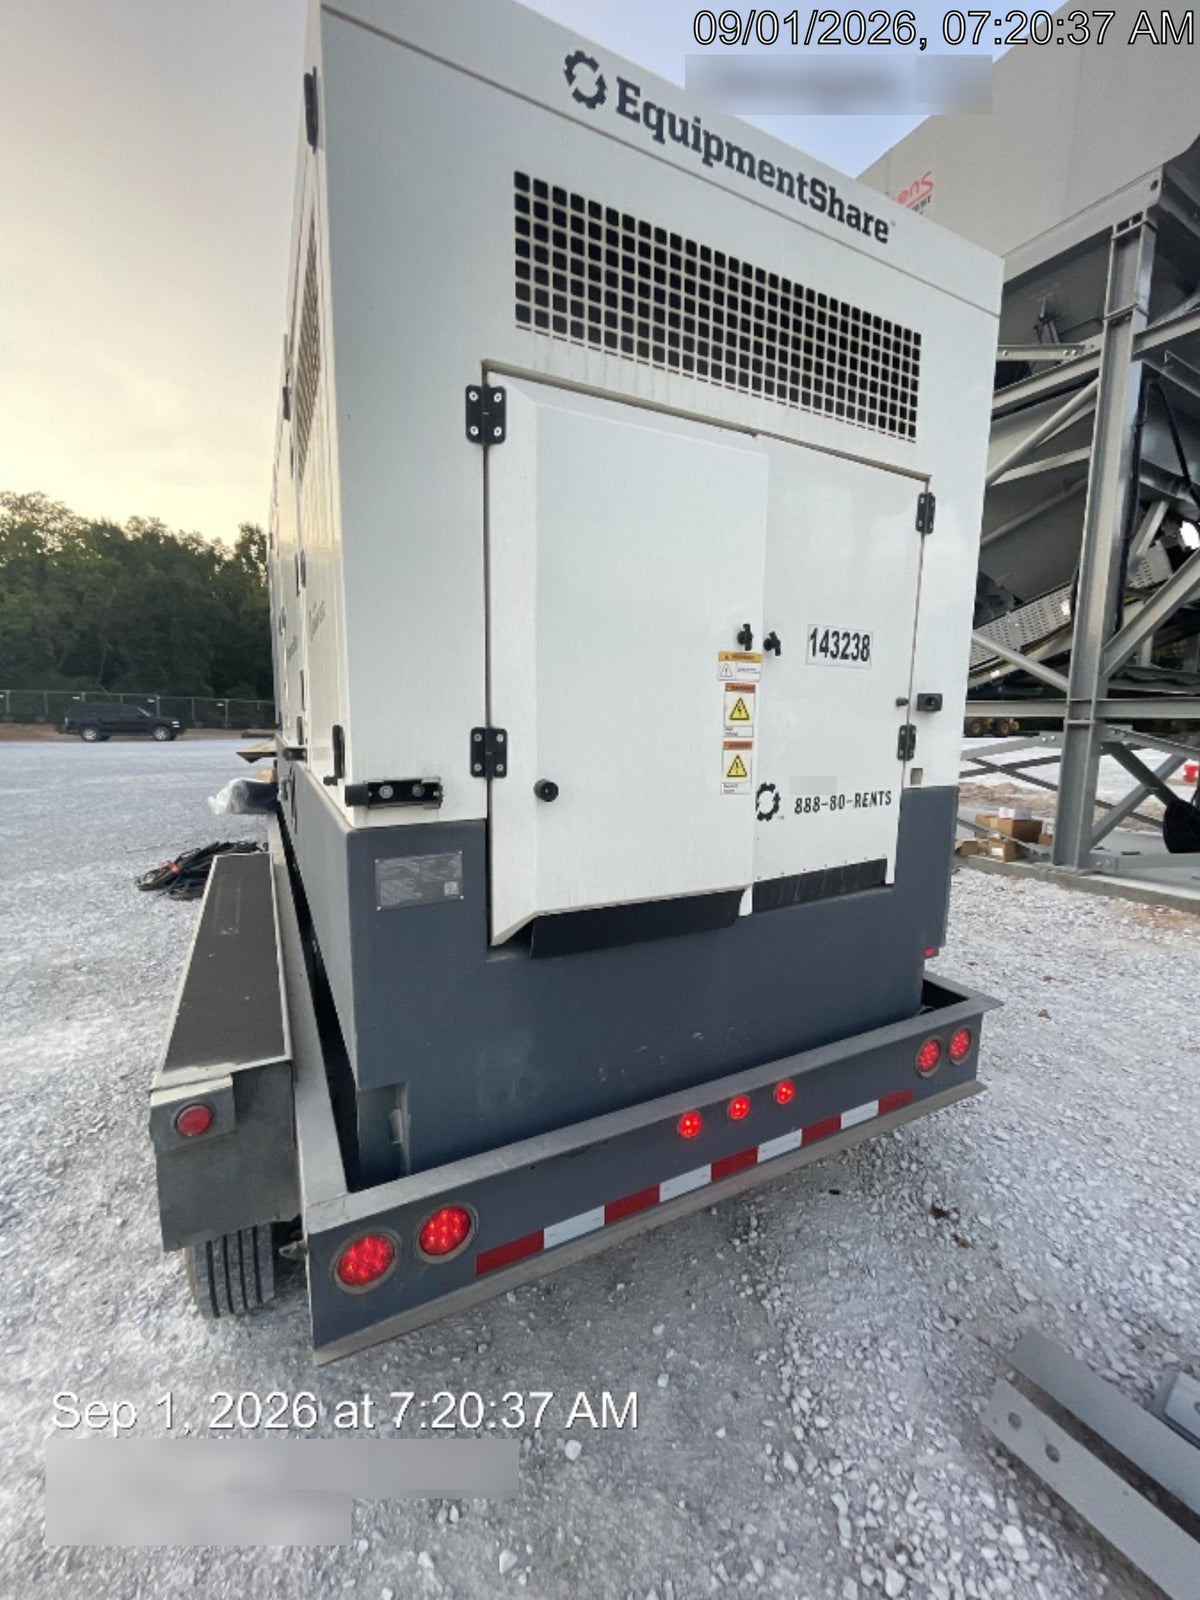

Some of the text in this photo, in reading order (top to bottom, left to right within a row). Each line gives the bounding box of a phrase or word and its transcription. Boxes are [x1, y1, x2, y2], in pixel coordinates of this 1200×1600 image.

[616, 75, 889, 245] EquipmentShare
[810, 627, 871, 662] 143238
[794, 790, 893, 815] 888-80-RENTS
